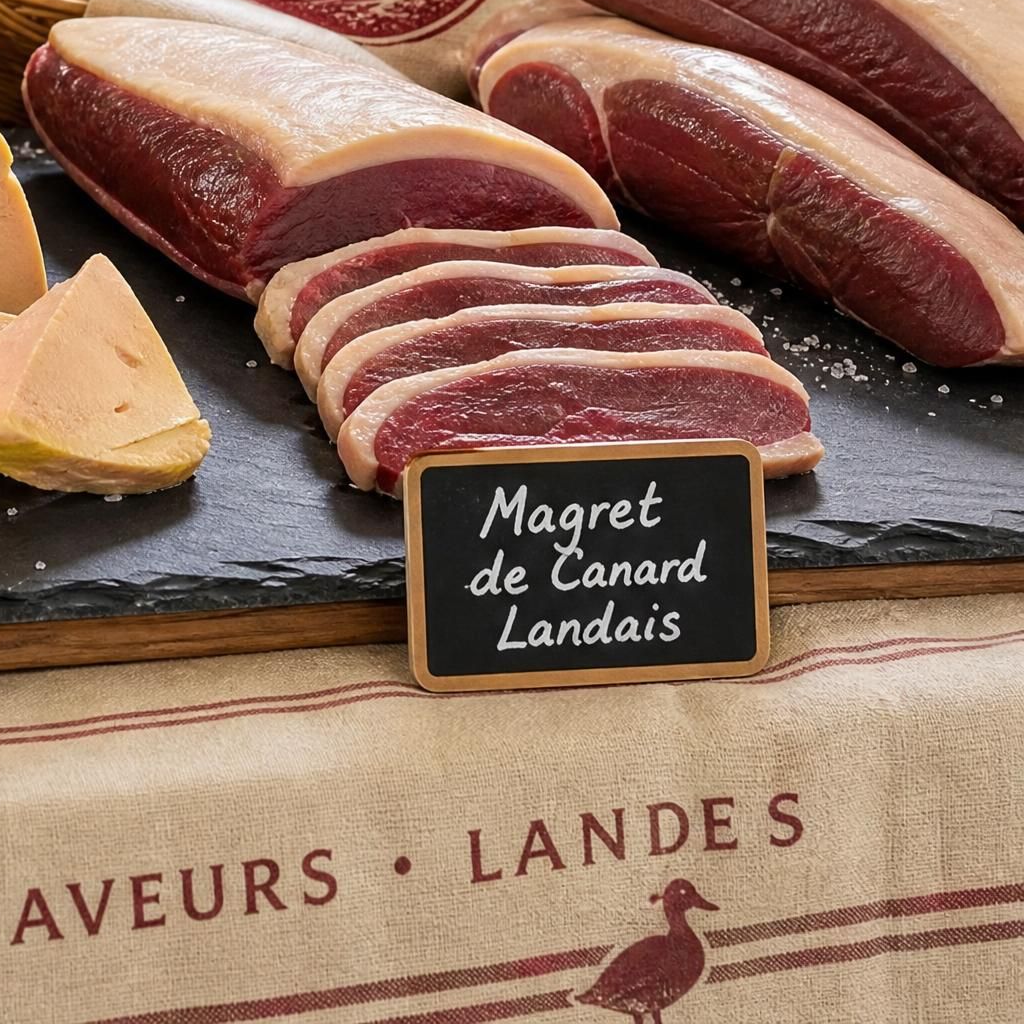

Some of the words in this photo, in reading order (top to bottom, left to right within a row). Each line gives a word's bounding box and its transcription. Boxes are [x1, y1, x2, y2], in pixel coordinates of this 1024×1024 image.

[480, 481, 663, 554] Magret
[467, 549, 528, 596] de
[551, 539, 707, 591] Canard
[497, 600, 680, 651] Landais
